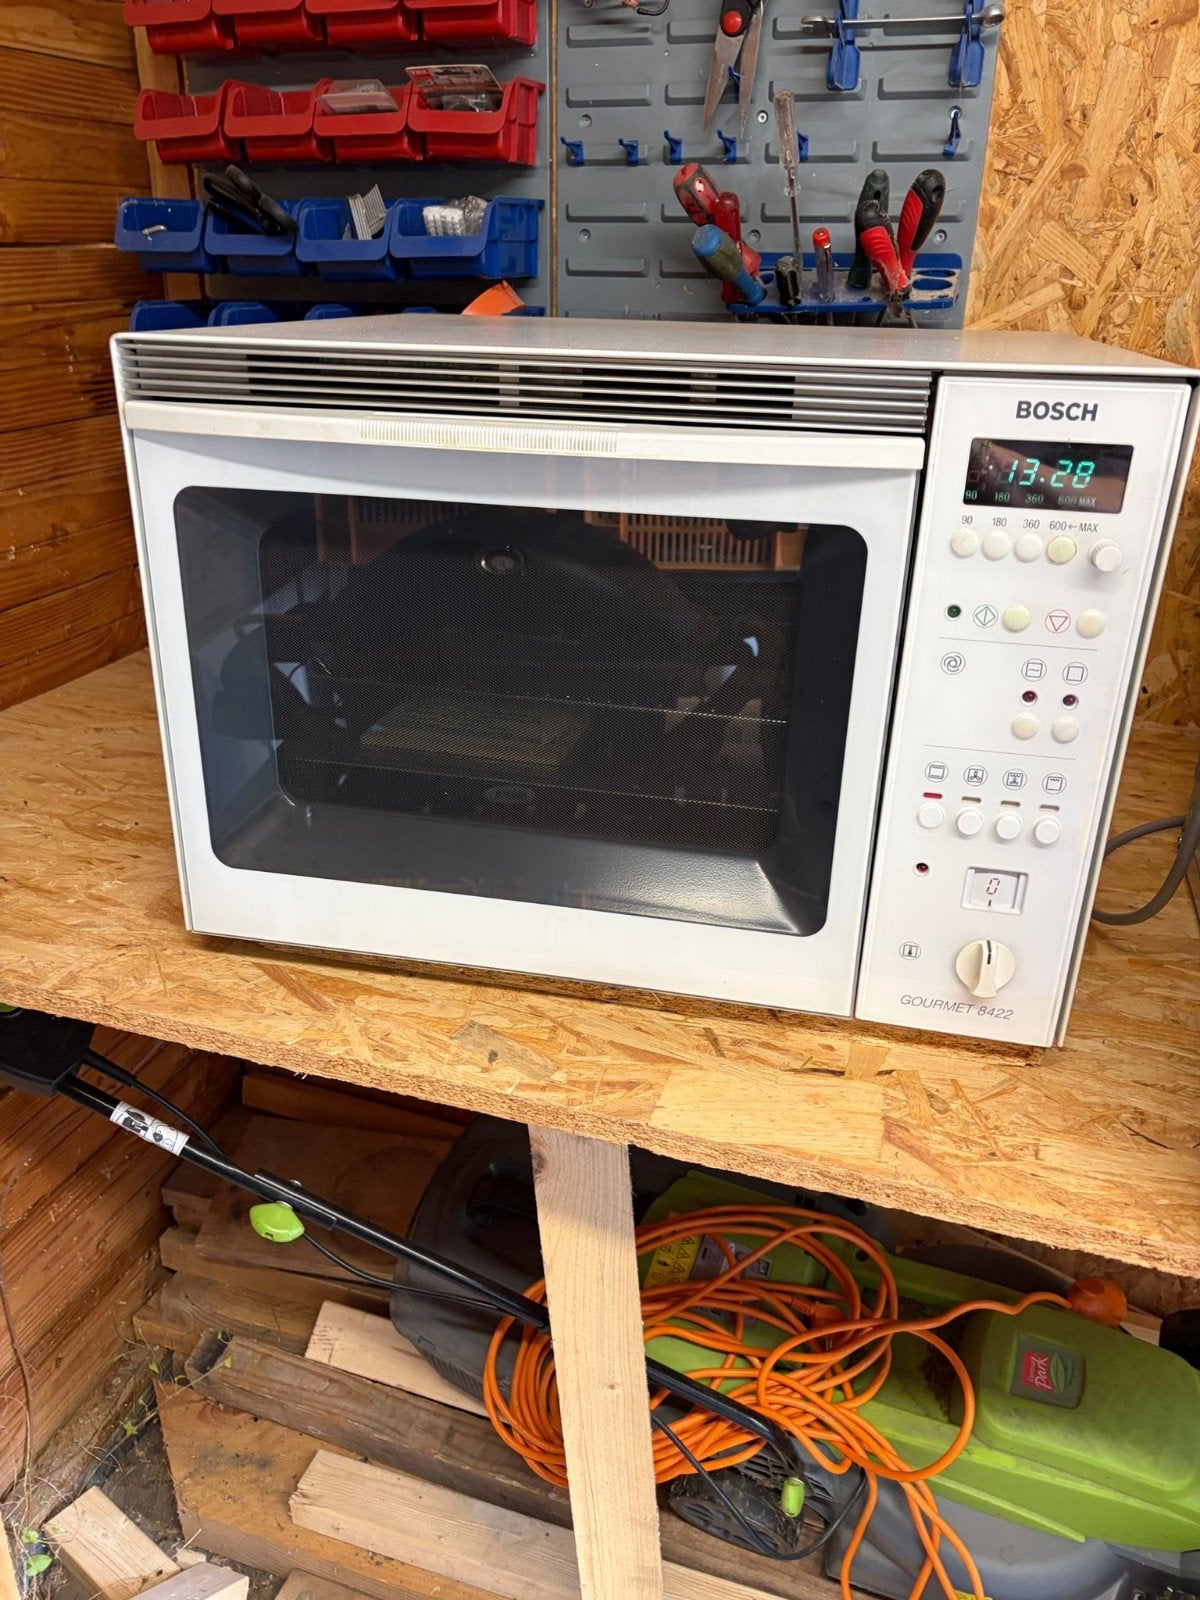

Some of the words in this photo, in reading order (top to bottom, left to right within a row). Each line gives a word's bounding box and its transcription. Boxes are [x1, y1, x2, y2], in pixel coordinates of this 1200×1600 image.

[1015, 401, 1099, 422] BOSCH
[1007, 458, 1095, 489] 13.28
[965, 490, 978, 500] 90
[994, 492, 1011, 502] 180
[1025, 494, 1044, 504] 360
[1078, 496, 1097, 507] MAX
[961, 515, 973, 525] 90
[992, 517, 1008, 527] 180
[1022, 519, 1040, 529] 360
[1049, 520, 1067, 531] 600
[1079, 522, 1099, 533] MAX
[900, 994, 975, 1014] GOURMET
[977, 1005, 1014, 1020] 8422
